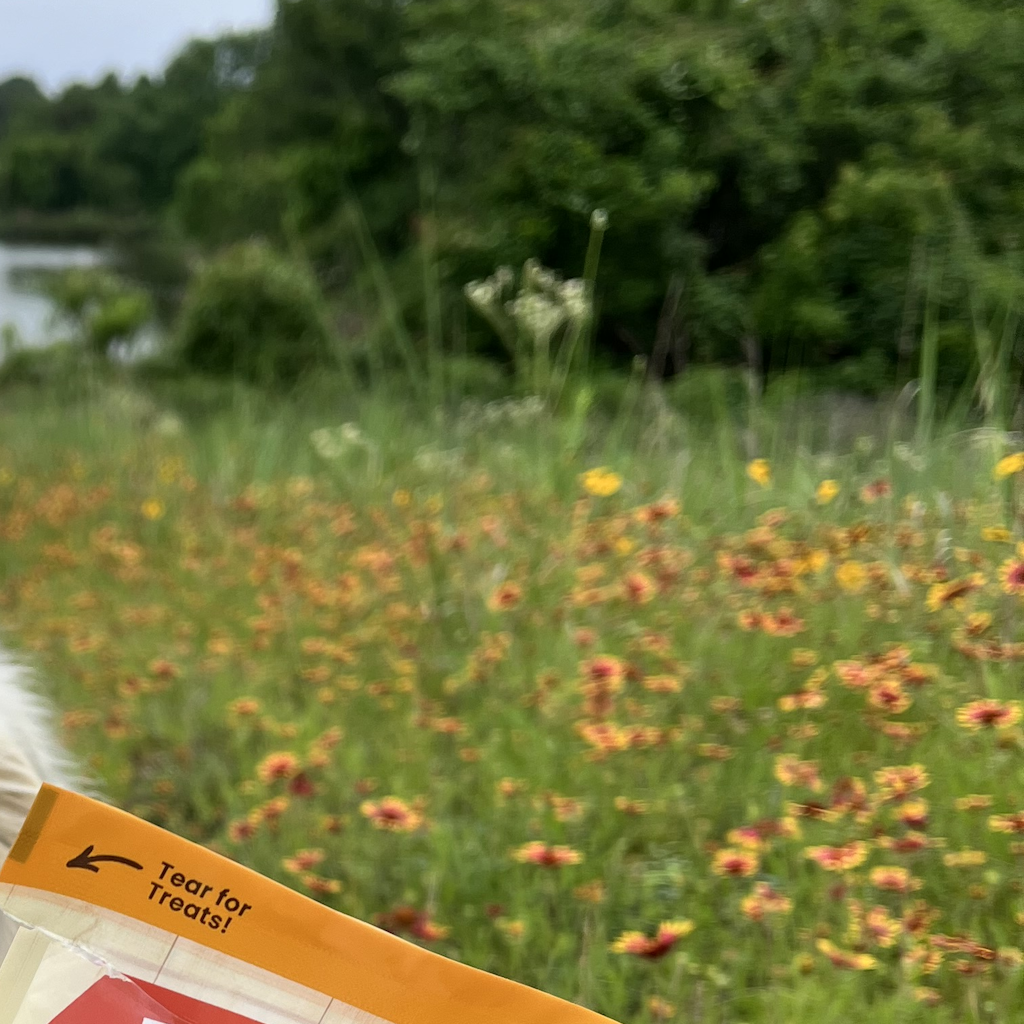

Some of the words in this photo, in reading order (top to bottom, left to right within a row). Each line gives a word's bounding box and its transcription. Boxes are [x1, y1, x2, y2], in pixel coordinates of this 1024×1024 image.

[148, 881, 233, 934] Treats!
[160, 861, 212, 899] Tear
[219, 888, 253, 917] for
